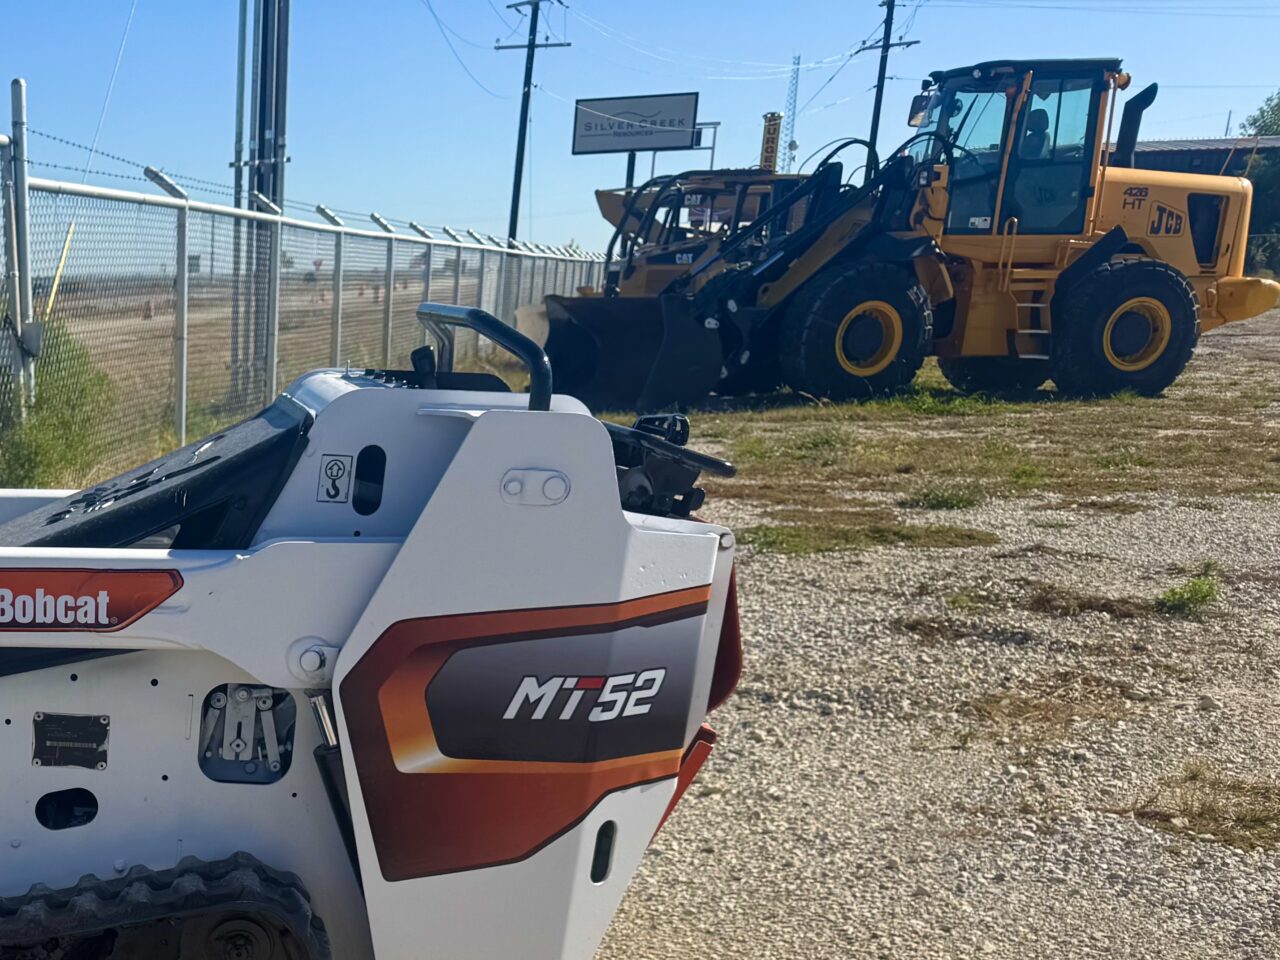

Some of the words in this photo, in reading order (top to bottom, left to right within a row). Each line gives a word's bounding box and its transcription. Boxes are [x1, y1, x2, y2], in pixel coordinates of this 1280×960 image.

[583, 120, 634, 132] SILVER
[638, 118, 686, 129] CREEK
[1123, 187, 1149, 197] 426
[684, 194, 702, 205] CAT
[1122, 198, 1146, 209] HT
[1149, 205, 1183, 235] JCB
[675, 253, 693, 264] CAT
[501, 667, 667, 722] MT52
